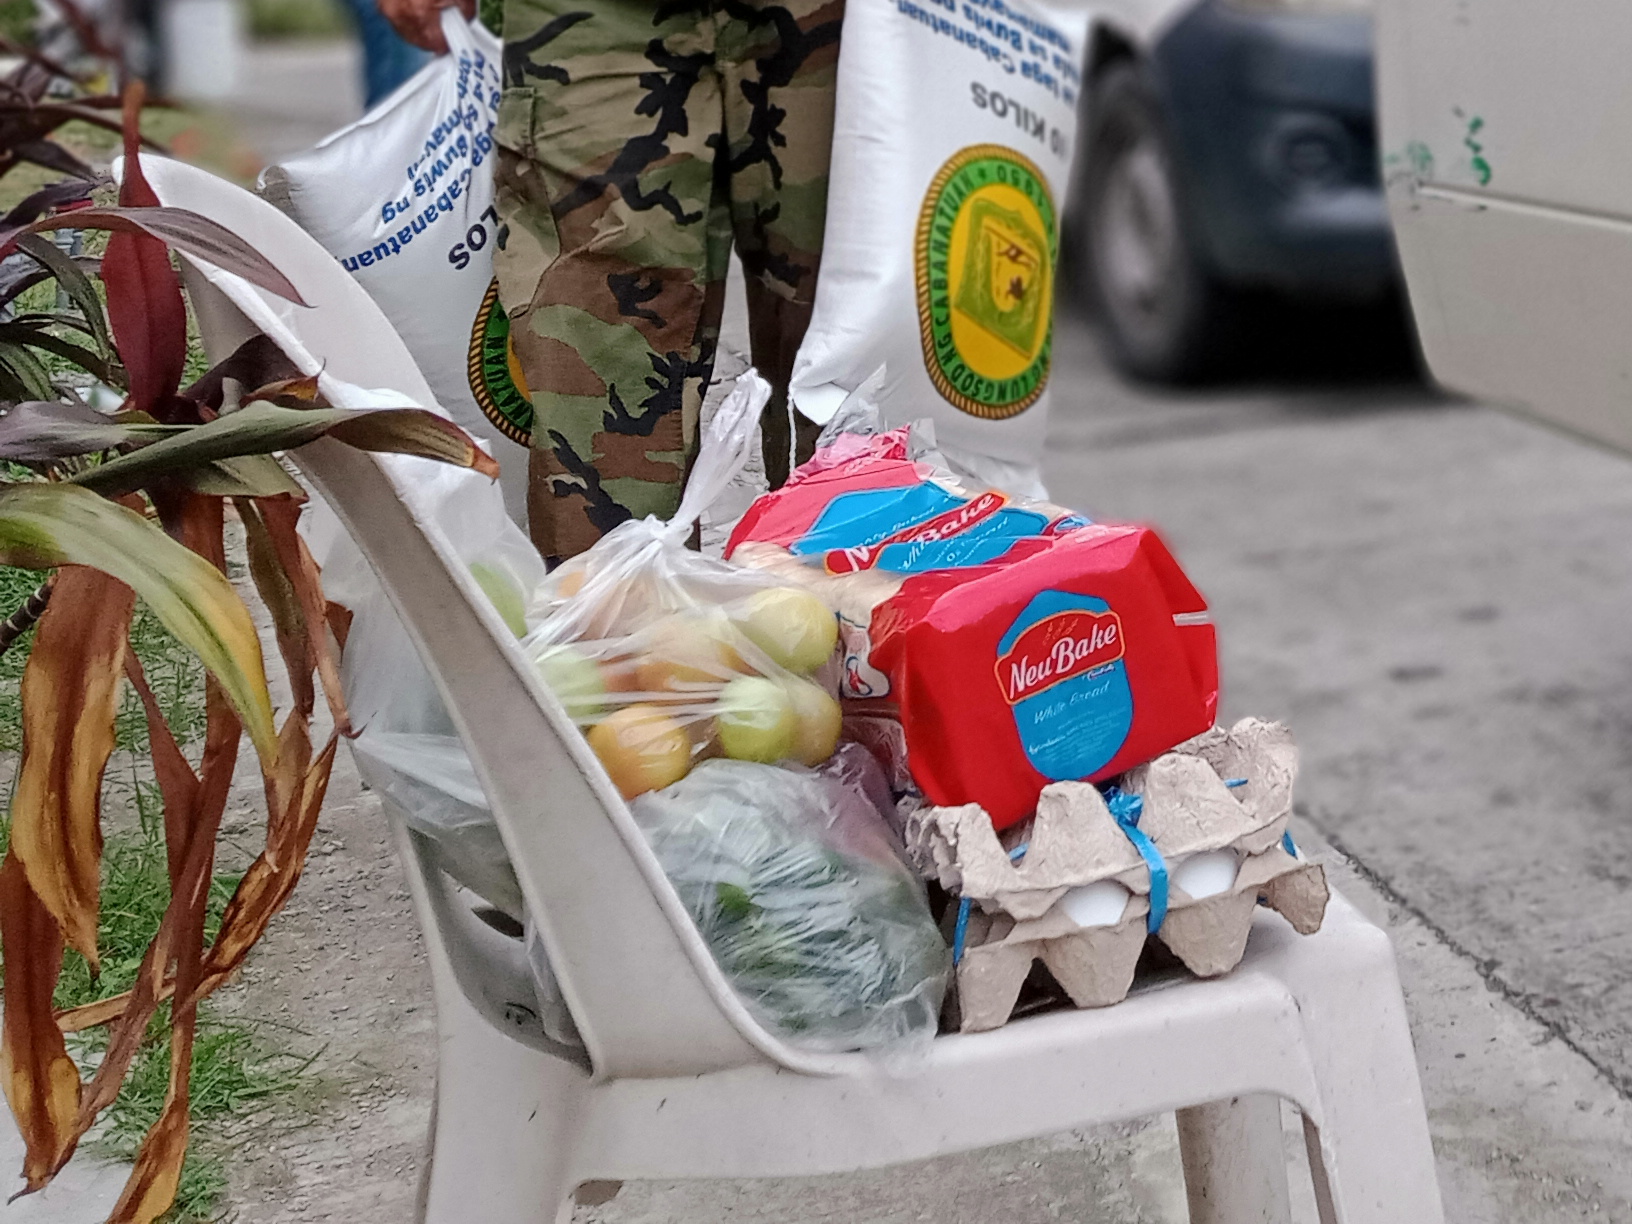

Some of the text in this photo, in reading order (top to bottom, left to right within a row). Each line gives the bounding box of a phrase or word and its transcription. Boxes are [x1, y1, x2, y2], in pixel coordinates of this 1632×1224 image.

[970, 81, 1046, 144] KILOS
[381, 195, 411, 225] ng
[448, 205, 499, 270] LOS
[936, 332, 957, 367] NG
[486, 335, 533, 432] NATUAN
[950, 362, 1029, 402] LUNGSOD
